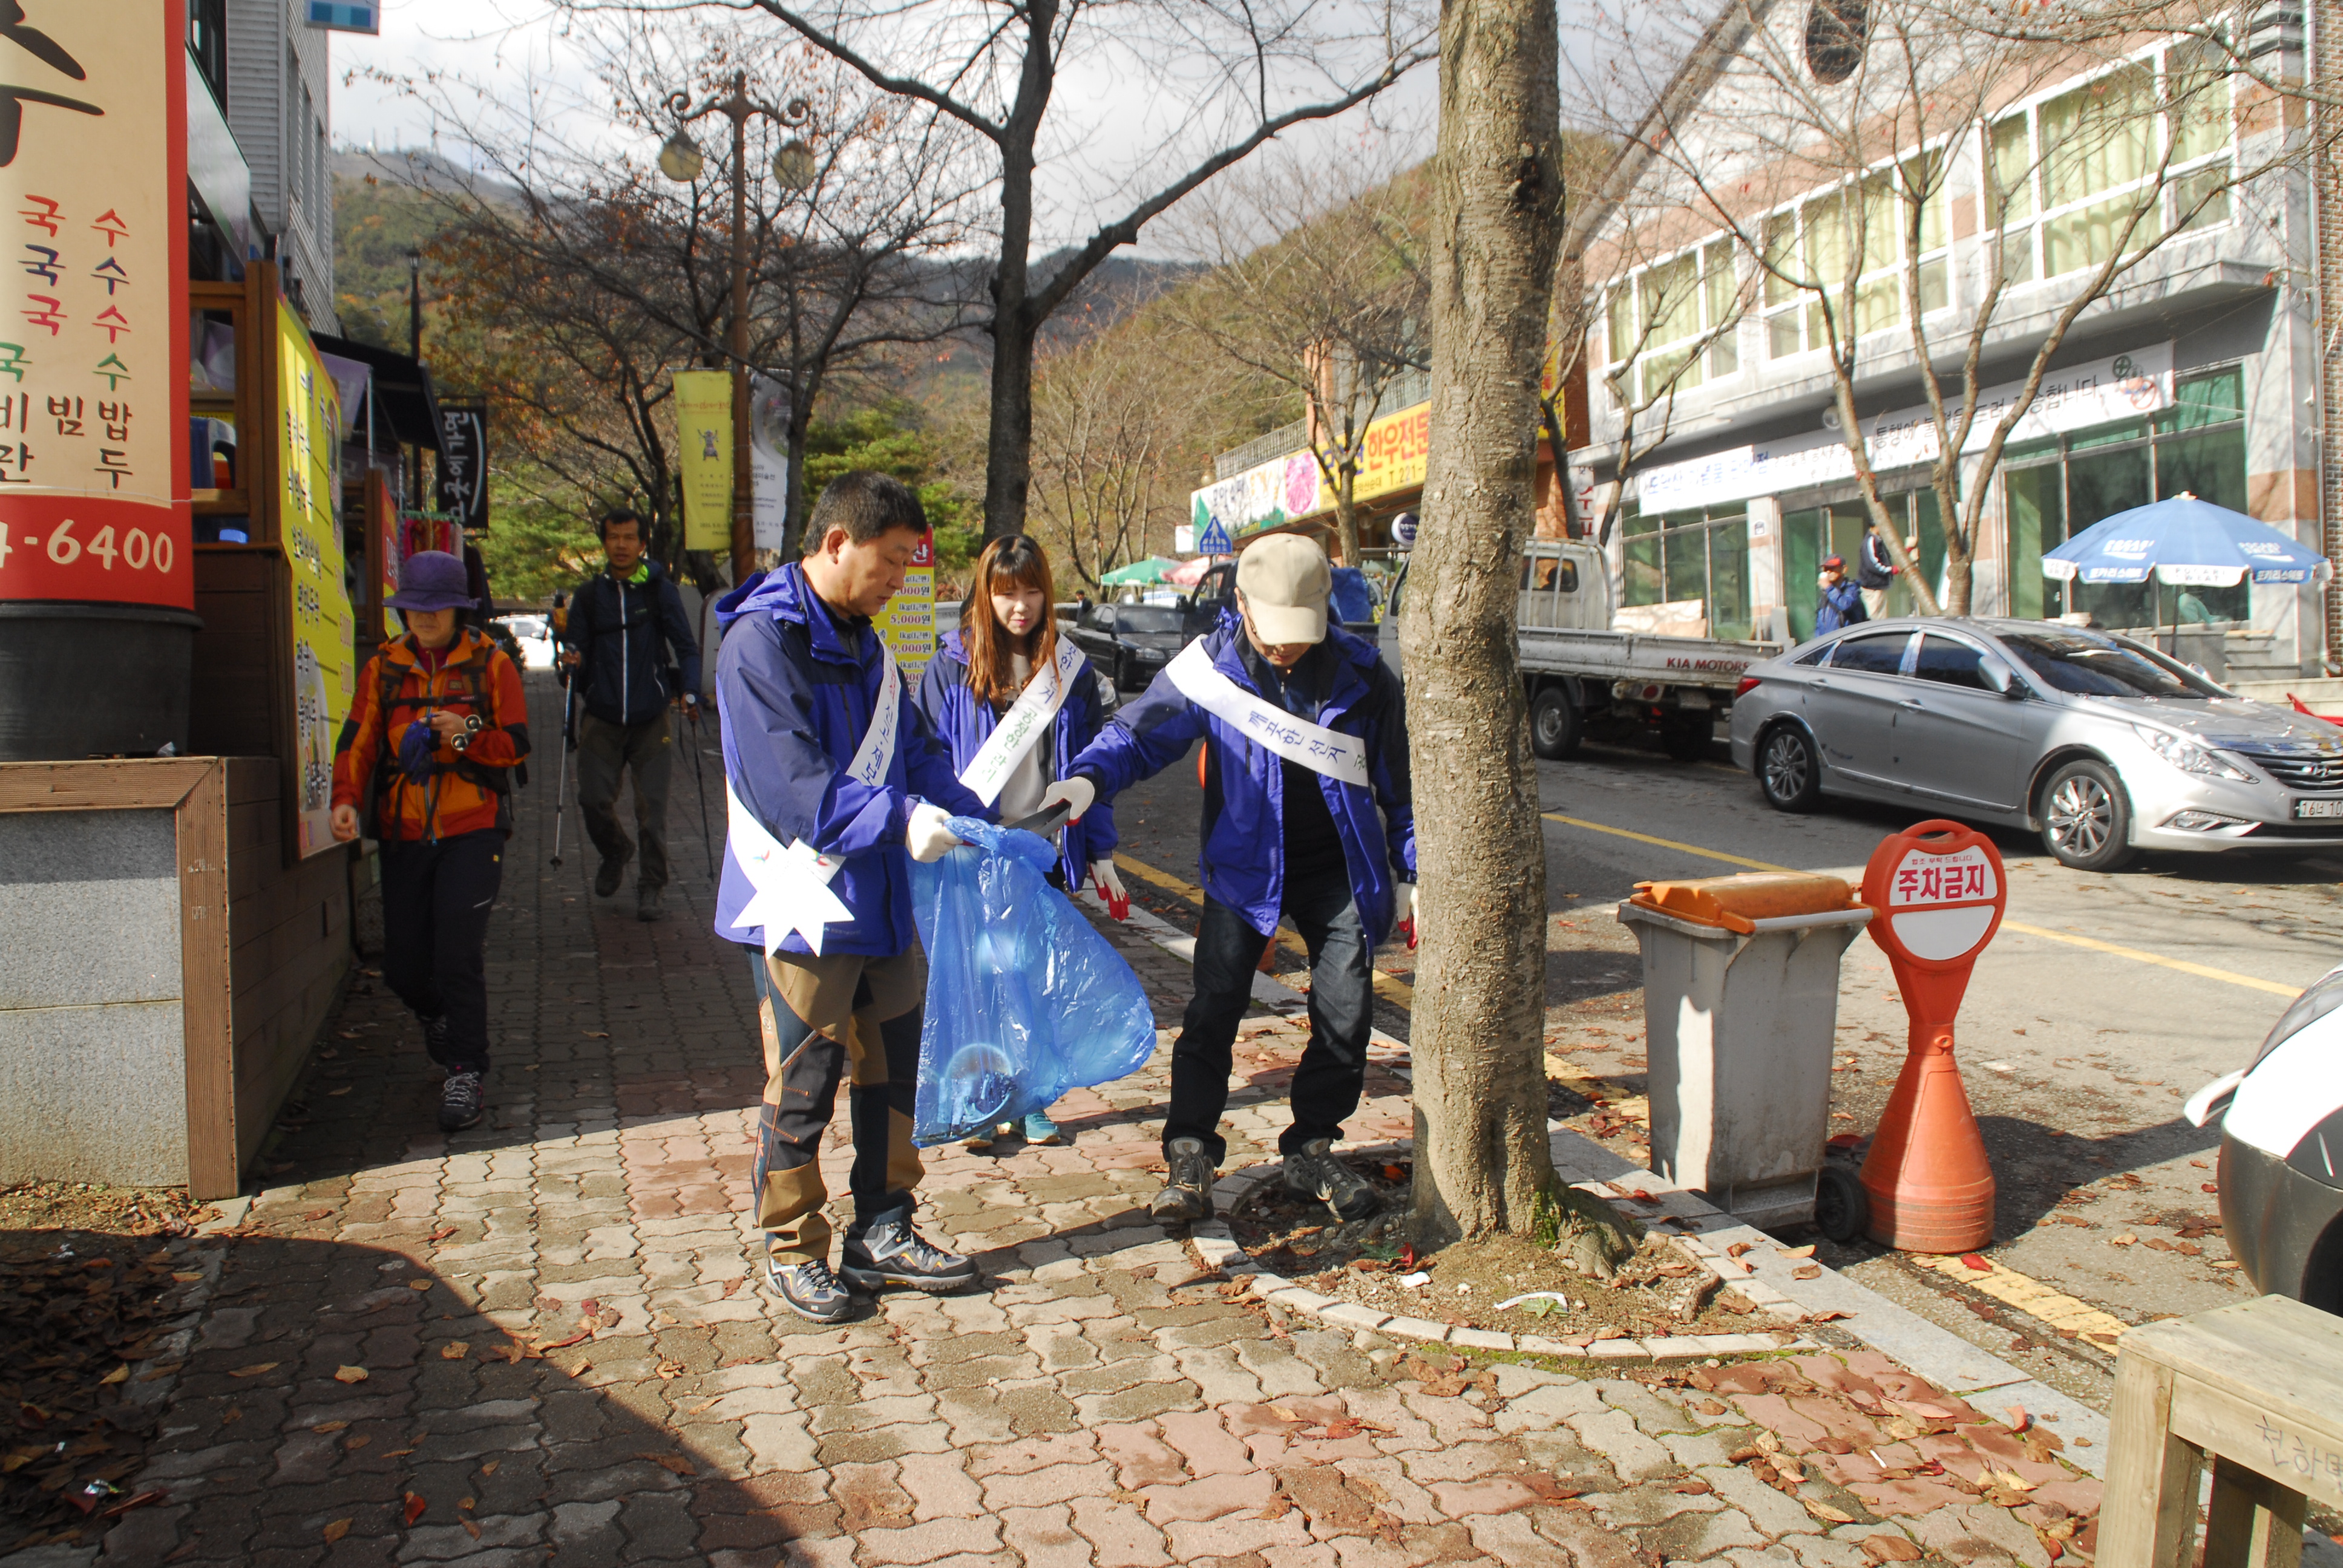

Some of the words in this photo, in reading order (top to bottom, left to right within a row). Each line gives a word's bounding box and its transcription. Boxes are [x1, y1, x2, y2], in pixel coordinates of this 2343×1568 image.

[1876, 419, 1917, 448] 통행에
[2014, 374, 2104, 415] 송합니다.
[890, 615, 931, 626] 5,000원
[891, 643, 931, 654] 9,000원
[1666, 658, 1691, 669] KIA
[1695, 659, 1749, 672] MOTORS
[1004, 707, 1038, 752] 공정한
[1248, 710, 1305, 747] 깨끗한
[1308, 739, 1347, 765] 선거
[981, 752, 1007, 783] 관리
[1945, 854, 1973, 863] 드립니다
[1898, 864, 1985, 902] 주차금지
